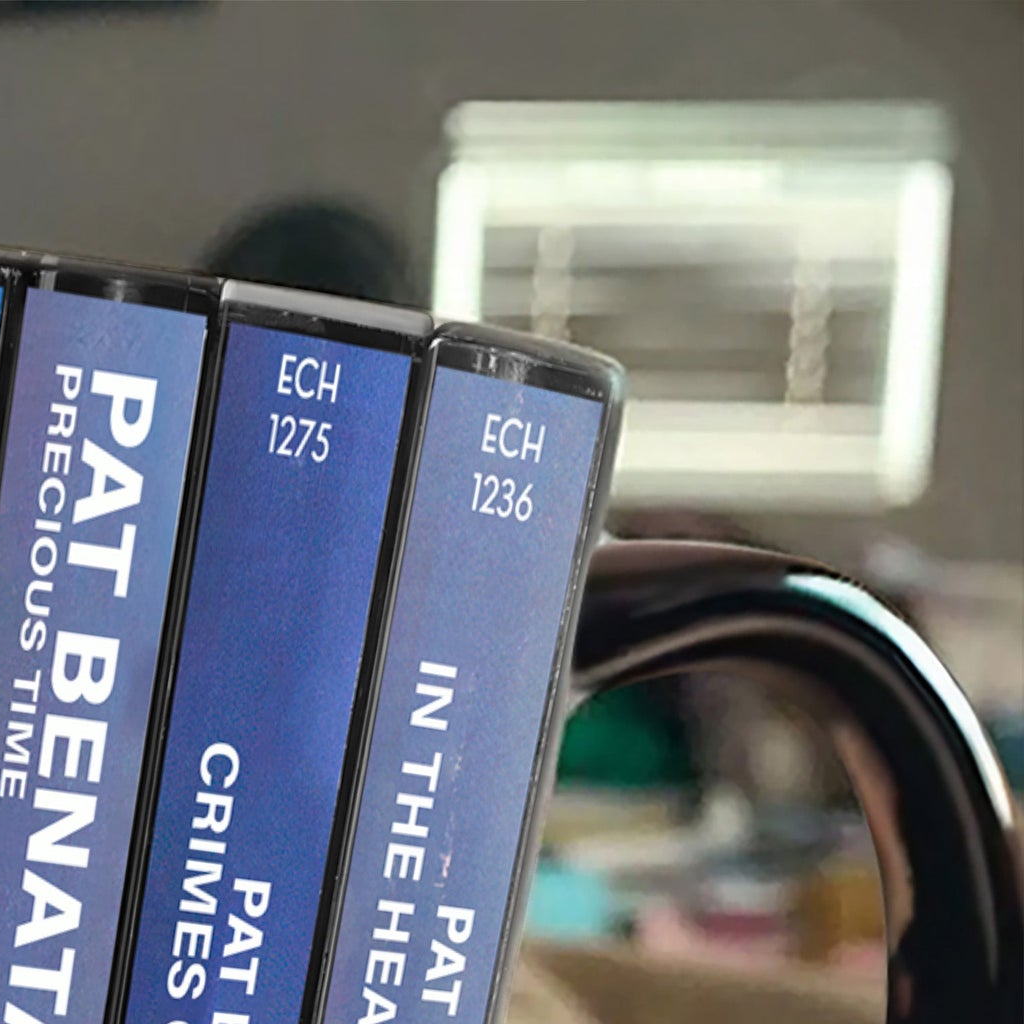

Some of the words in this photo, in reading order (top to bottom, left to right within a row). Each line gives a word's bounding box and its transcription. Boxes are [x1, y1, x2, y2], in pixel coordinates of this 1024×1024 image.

[277, 353, 342, 404] ECH
[67, 369, 158, 599] PAT
[268, 412, 333, 463] 1275
[480, 412, 547, 464] ECH
[19, 363, 84, 652] PRECIOUS
[470, 471, 535, 523] 1236
[410, 661, 459, 731] IN
[167, 742, 240, 1000] CRIMES
[382, 751, 443, 882] THE
[219, 878, 271, 996] PAT
[421, 905, 477, 1018] PAT
